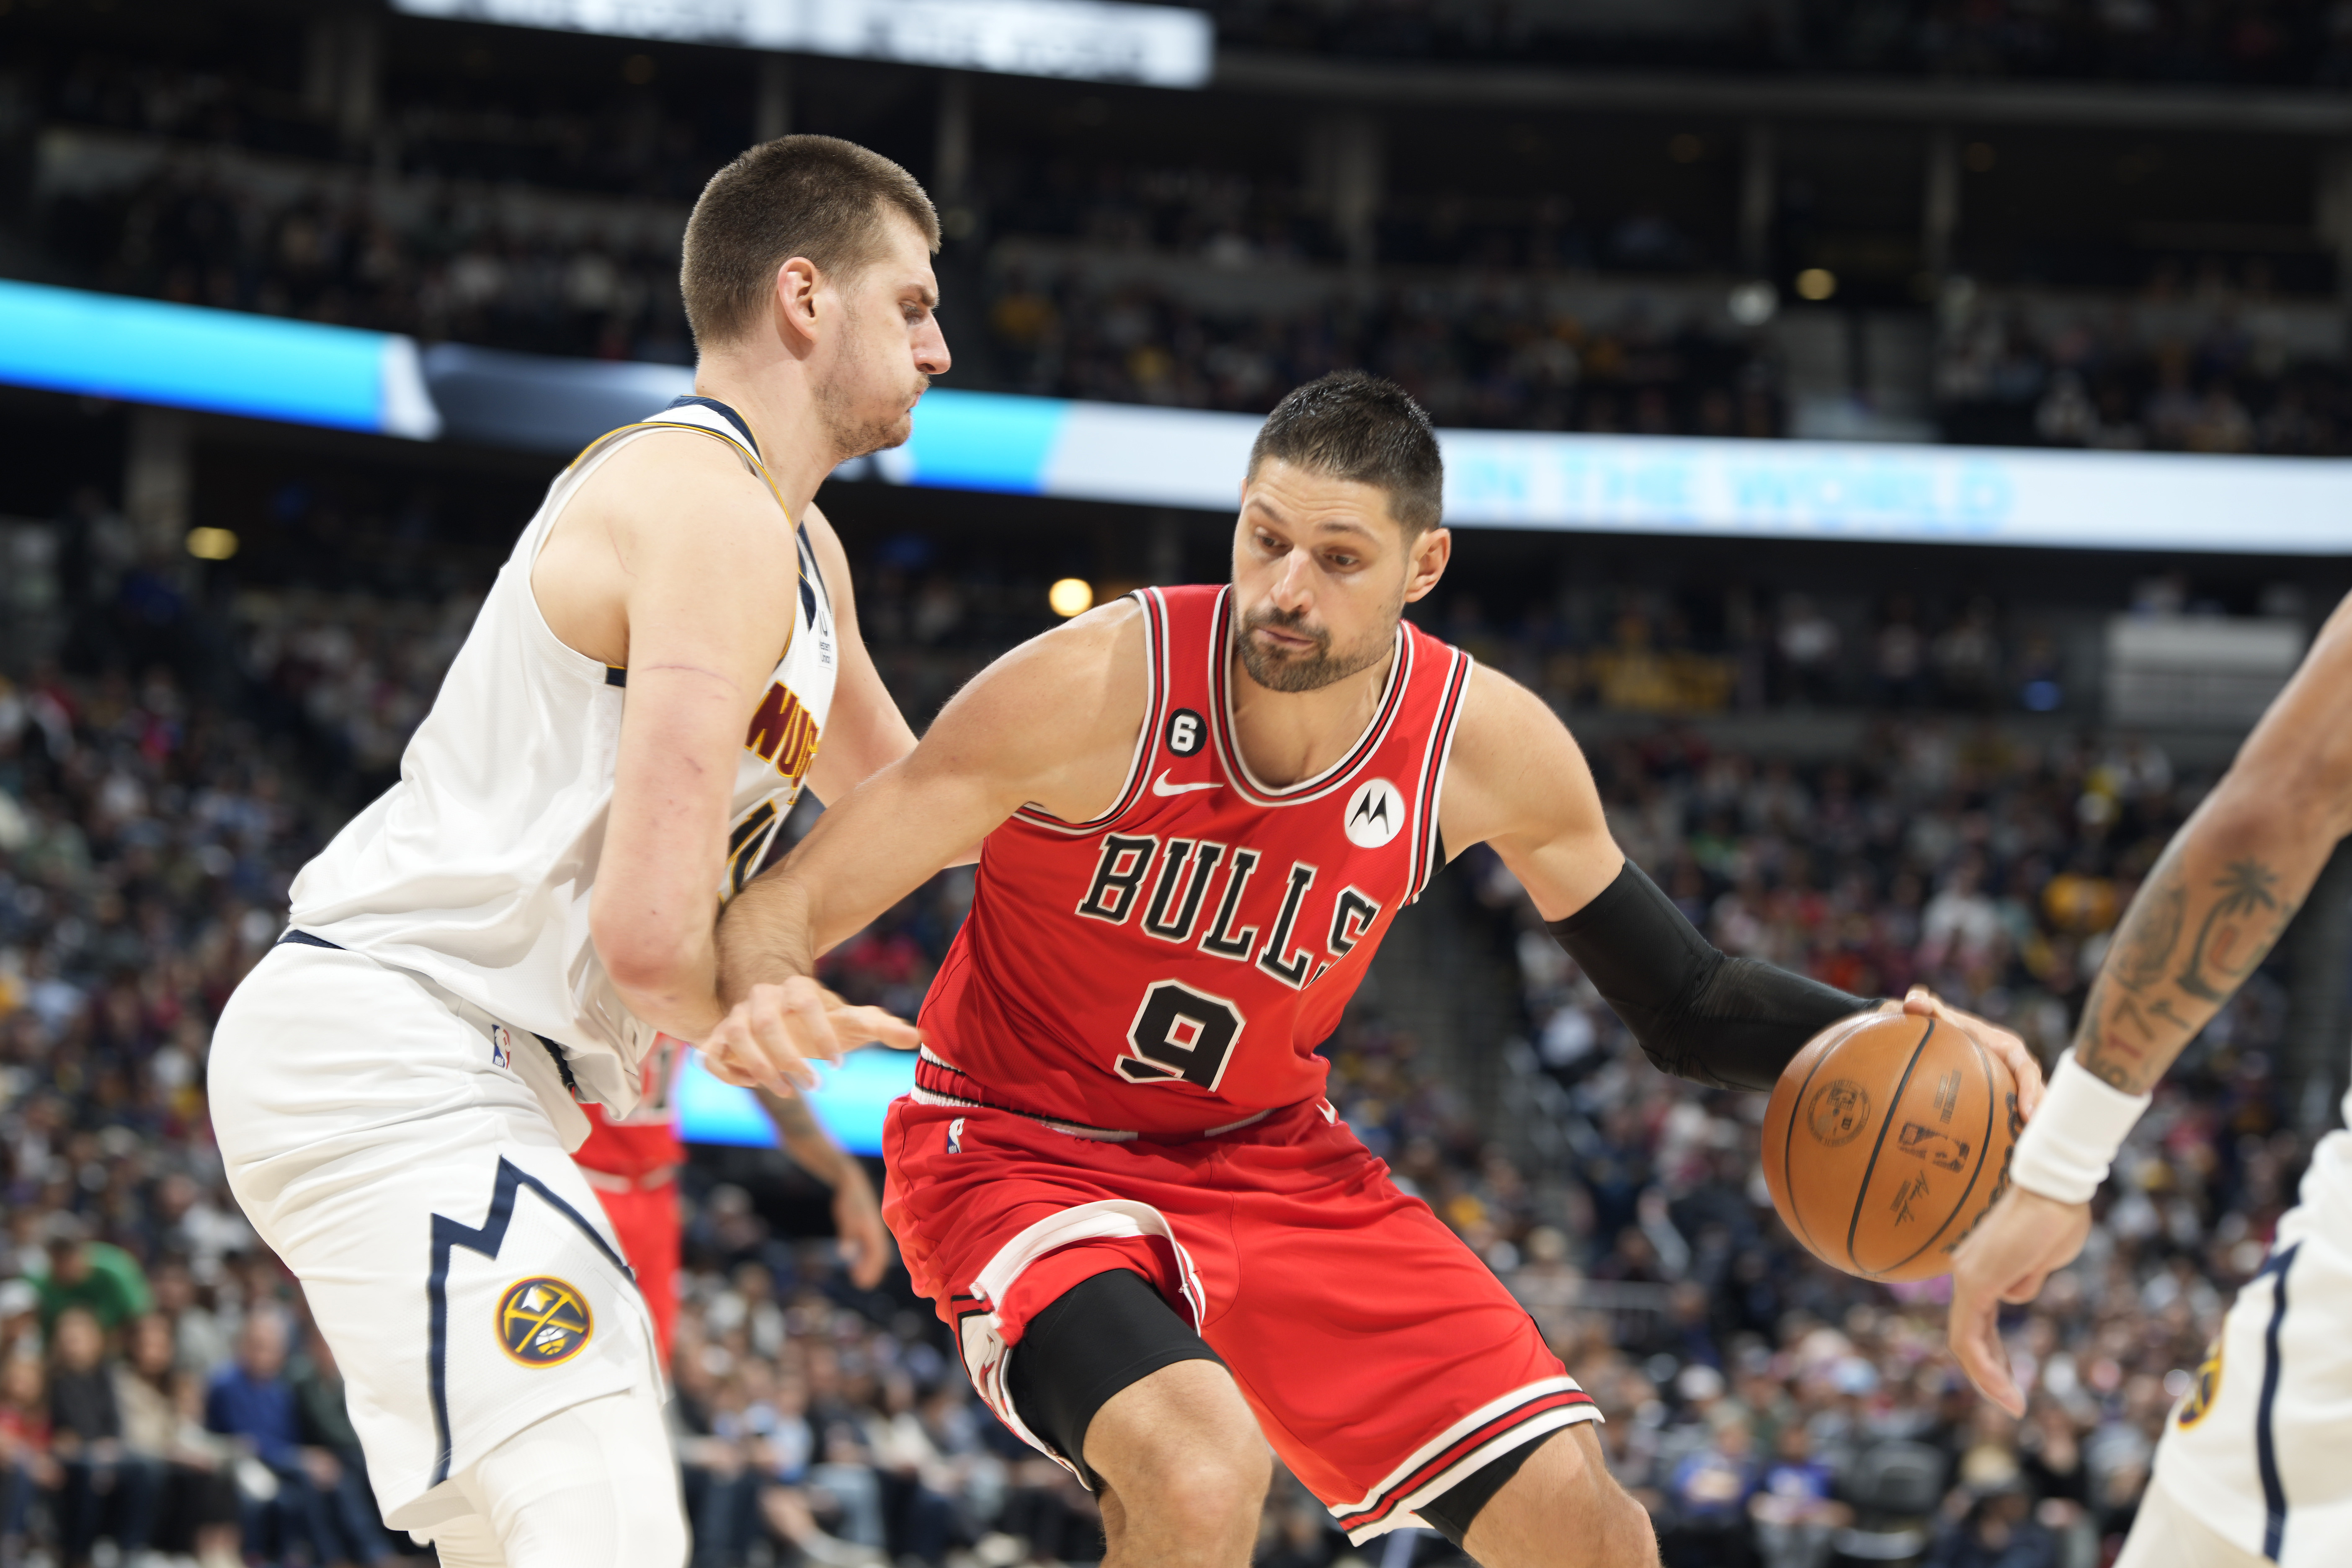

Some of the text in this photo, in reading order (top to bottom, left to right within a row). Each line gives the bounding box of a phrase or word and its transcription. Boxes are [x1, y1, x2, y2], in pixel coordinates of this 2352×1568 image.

[1554, 446, 1703, 529] THE
[1728, 454, 2015, 537] WORLD
[744, 680, 821, 805] NUG
[1171, 714, 1198, 752] 6
[1075, 832, 1381, 991] BULLS
[494, 1055, 504, 1067] NBA
[1113, 977, 1247, 1093] 9
[948, 1145, 957, 1154] NBA
